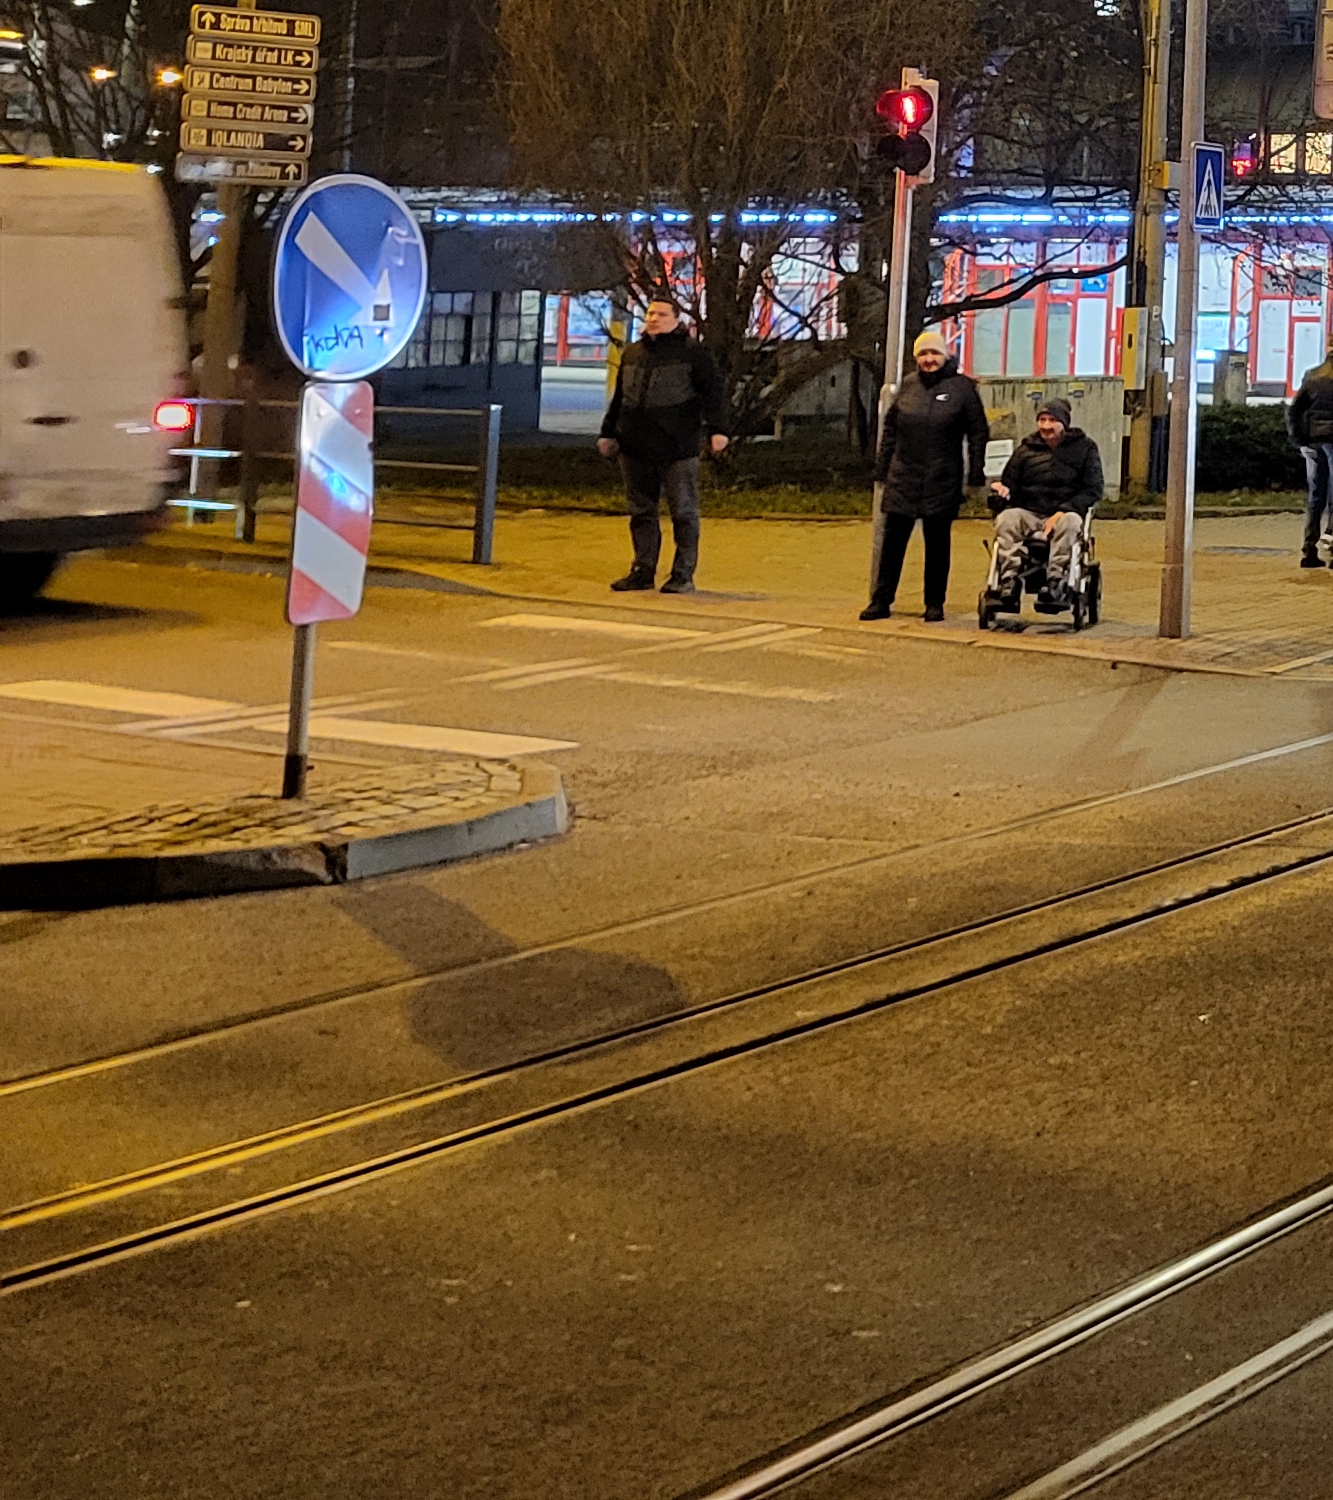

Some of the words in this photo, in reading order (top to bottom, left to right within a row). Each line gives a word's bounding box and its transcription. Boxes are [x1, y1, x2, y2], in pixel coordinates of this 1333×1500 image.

[220, 13, 251, 32] Správa
[215, 43, 254, 65] Krajský
[255, 47, 279, 64] úřad
[280, 49, 295, 65] LK
[212, 73, 253, 91] Centrum
[255, 75, 293, 95] Babylon
[209, 102, 235, 118] Home
[235, 103, 262, 120] Credit
[263, 105, 289, 122] Arena
